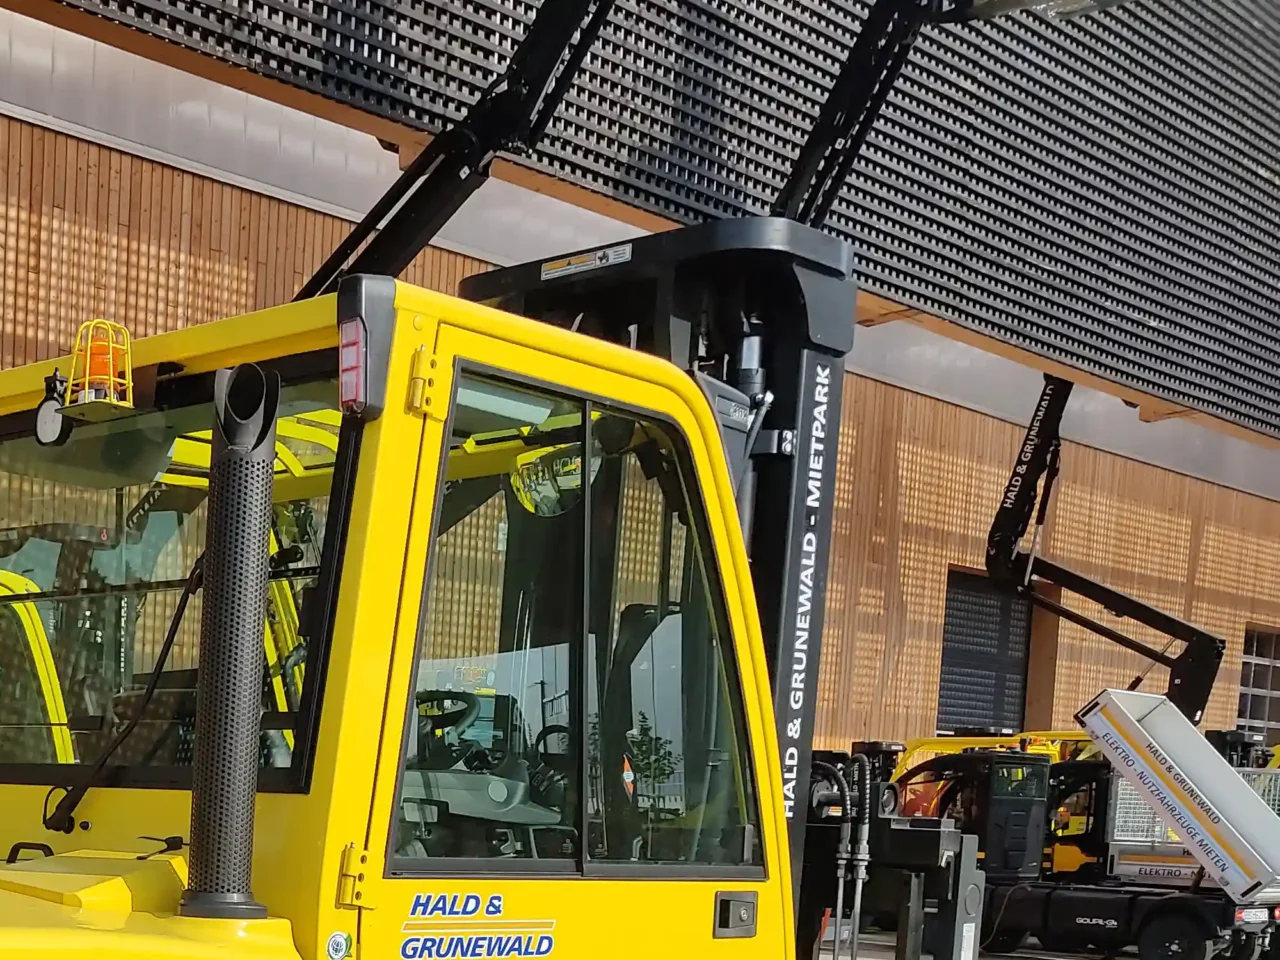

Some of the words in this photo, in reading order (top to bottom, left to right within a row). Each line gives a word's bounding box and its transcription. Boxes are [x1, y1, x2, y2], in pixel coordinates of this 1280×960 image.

[806, 364, 831, 508] MIETPARK
[1004, 476, 1022, 508] HALD
[1016, 464, 1028, 474] &
[789, 532, 816, 710] GRUNEWALD
[787, 717, 801, 740] &
[783, 746, 798, 818] HALD
[1102, 732, 1135, 768] ELEKTRO
[1136, 771, 1200, 840] NUTZFAHRZEUGE
[1196, 838, 1230, 873] MIETEN
[1145, 742, 1168, 766] HALD
[1165, 765, 1174, 775] &
[1173, 772, 1221, 825] GRUNEWALD
[1138, 867, 1181, 877] ELEKTRO
[410, 893, 480, 916] HALD
[485, 894, 503, 916] &
[401, 934, 554, 959] GRUNEWALD
